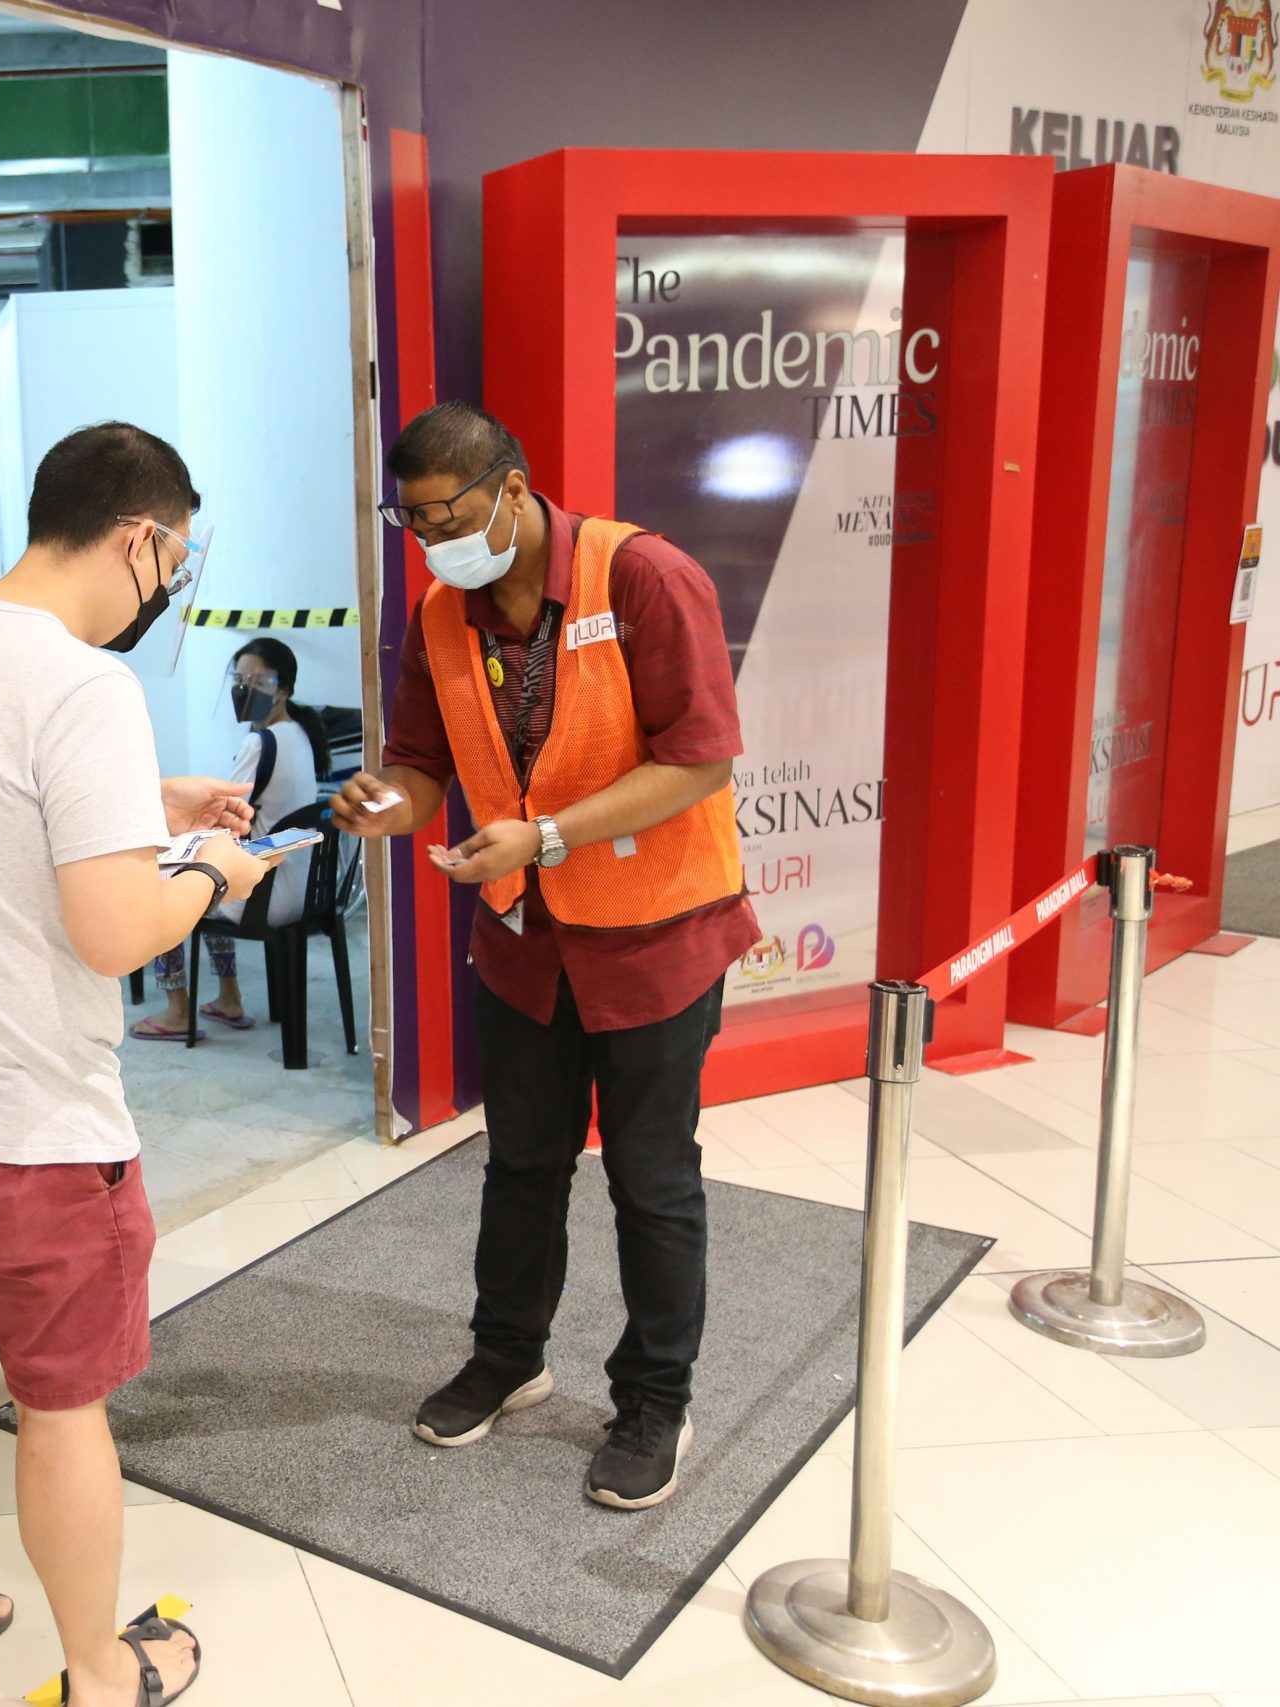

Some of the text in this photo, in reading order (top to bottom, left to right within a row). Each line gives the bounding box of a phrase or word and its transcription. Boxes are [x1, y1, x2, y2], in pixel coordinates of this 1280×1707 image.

[1188, 103, 1278, 124] KEMENTERIAN KESIHATAN
[1215, 122, 1251, 137] MALAYSIA
[1010, 106, 1180, 175] KELUAR
[614, 307, 940, 393] Pandemic
[802, 392, 937, 441] TIMES
[763, 760, 811, 785] telah
[1034, 868, 1089, 924] PARADIGM MALL
[949, 923, 1015, 986] PARADIGM MALL
